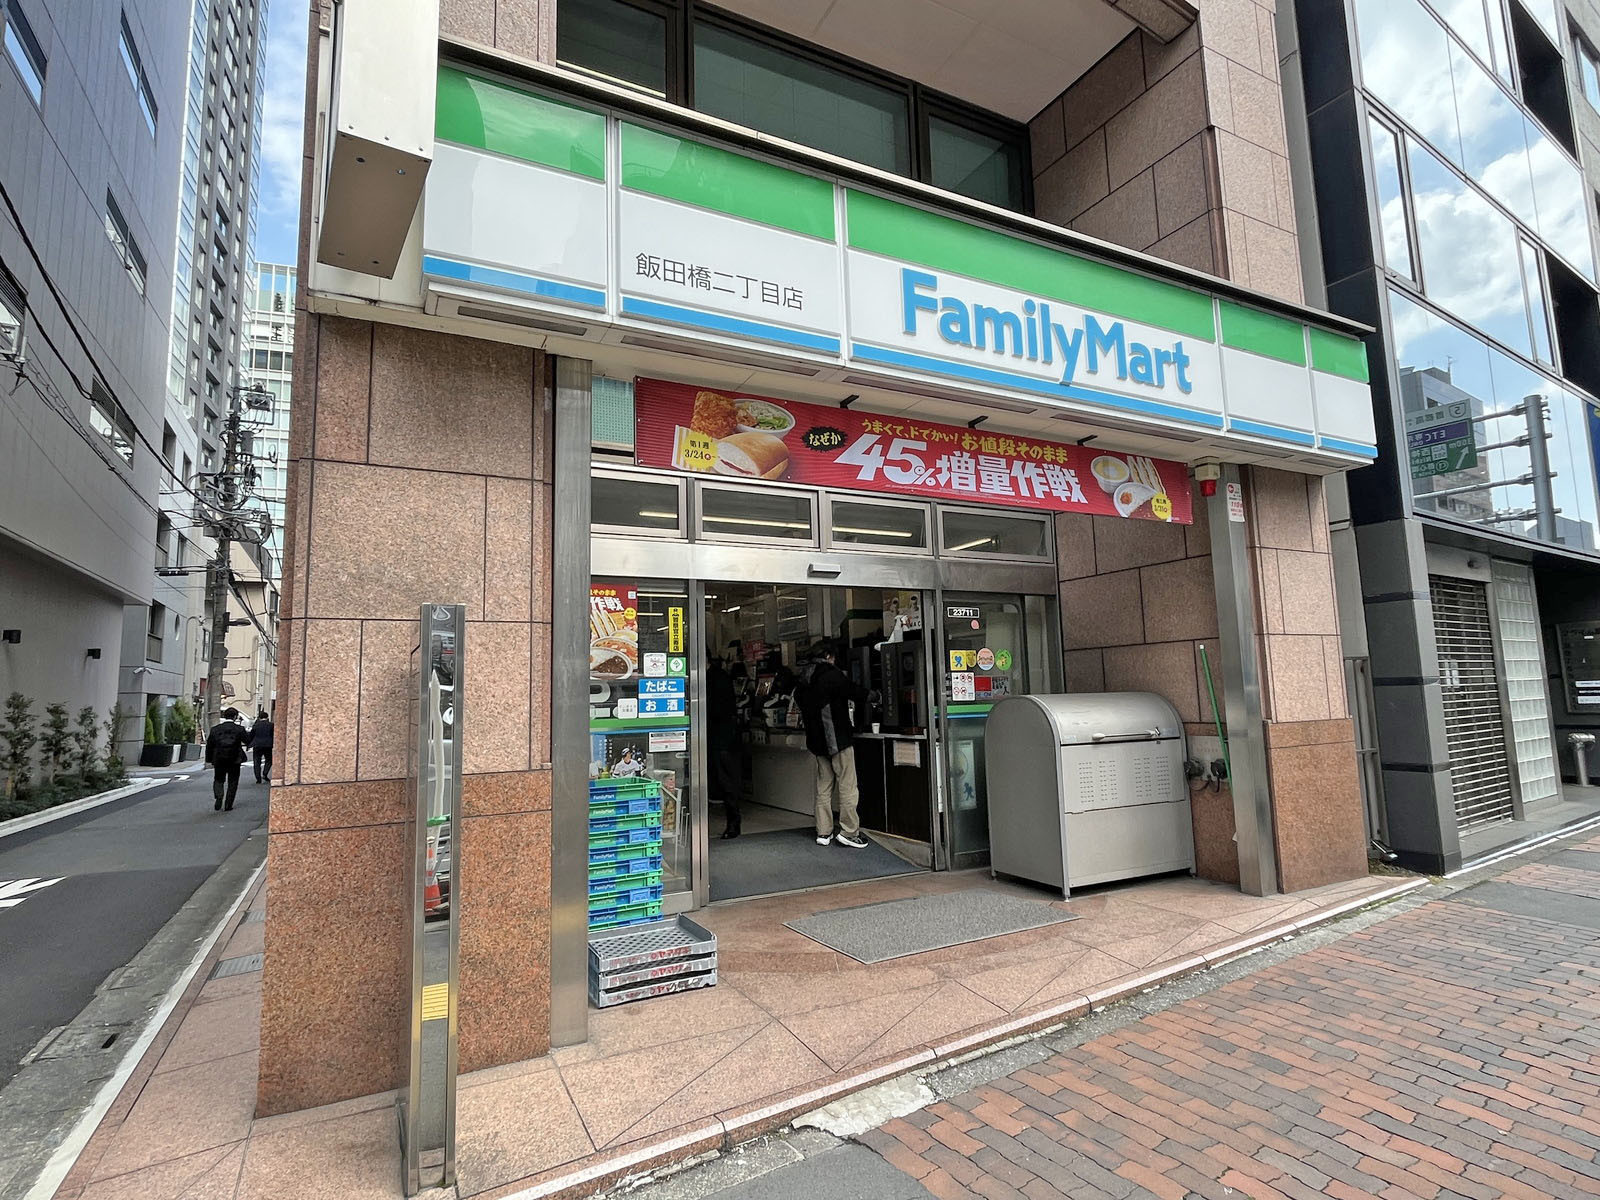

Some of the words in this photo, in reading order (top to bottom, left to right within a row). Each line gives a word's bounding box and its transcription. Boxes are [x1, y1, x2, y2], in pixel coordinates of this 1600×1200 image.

[635, 252, 804, 311] 飯田橋二丁目店
[901, 267, 1193, 394] FamilyMart
[808, 431, 842, 447] なぜか
[961, 434, 1068, 463] お値段そのまま
[952, 609, 973, 617] 23711
[645, 680, 677, 693] たばこ
